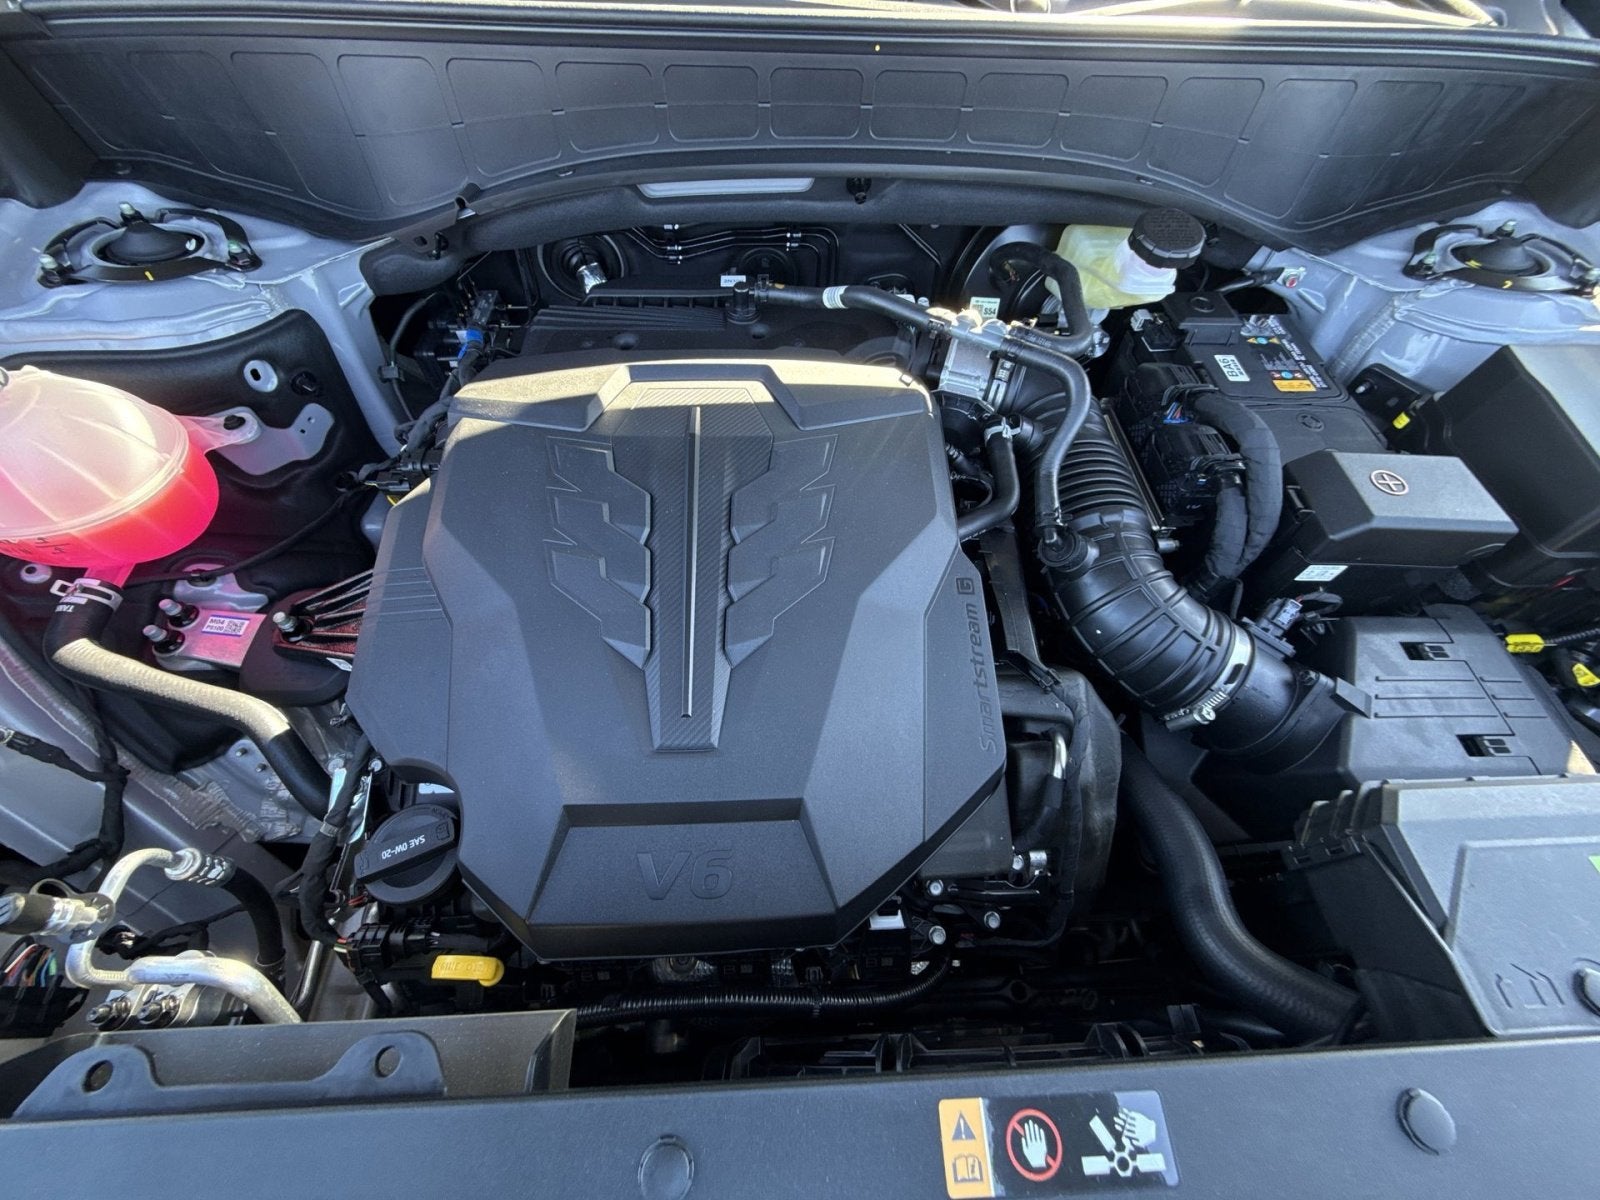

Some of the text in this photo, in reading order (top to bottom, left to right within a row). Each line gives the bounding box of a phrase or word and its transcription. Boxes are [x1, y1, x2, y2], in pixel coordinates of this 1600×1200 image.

[983, 307, 997, 316] S54
[1219, 358, 1239, 377] BA6
[966, 602, 997, 754] Smartstream
[381, 834, 426, 860] SAE 0W-20
[636, 849, 733, 900] V6
